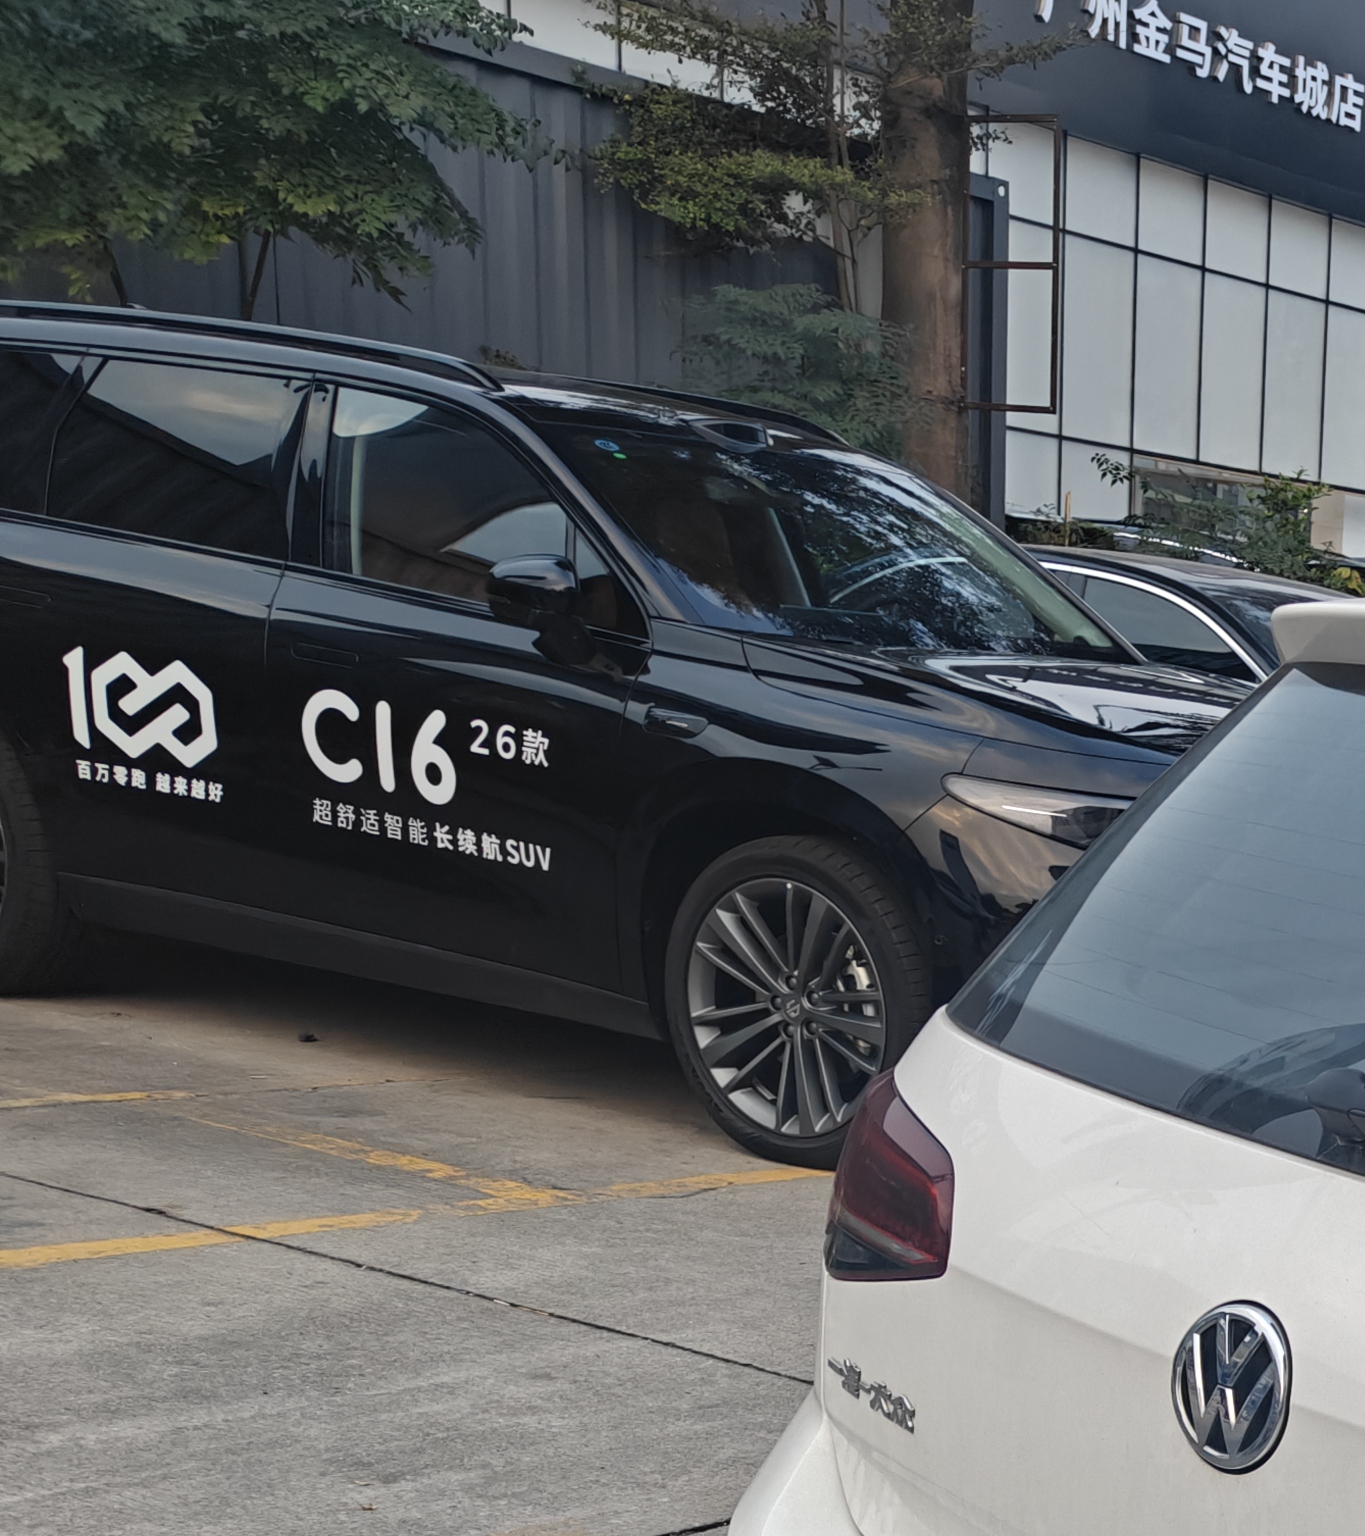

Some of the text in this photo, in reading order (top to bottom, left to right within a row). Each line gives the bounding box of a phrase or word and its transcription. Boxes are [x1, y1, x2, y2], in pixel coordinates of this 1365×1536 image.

[75, 759, 224, 803] 百万零跑 越来越好
[302, 688, 550, 806] C16 26款
[312, 798, 551, 871] 超舒适智能长续航SUV
